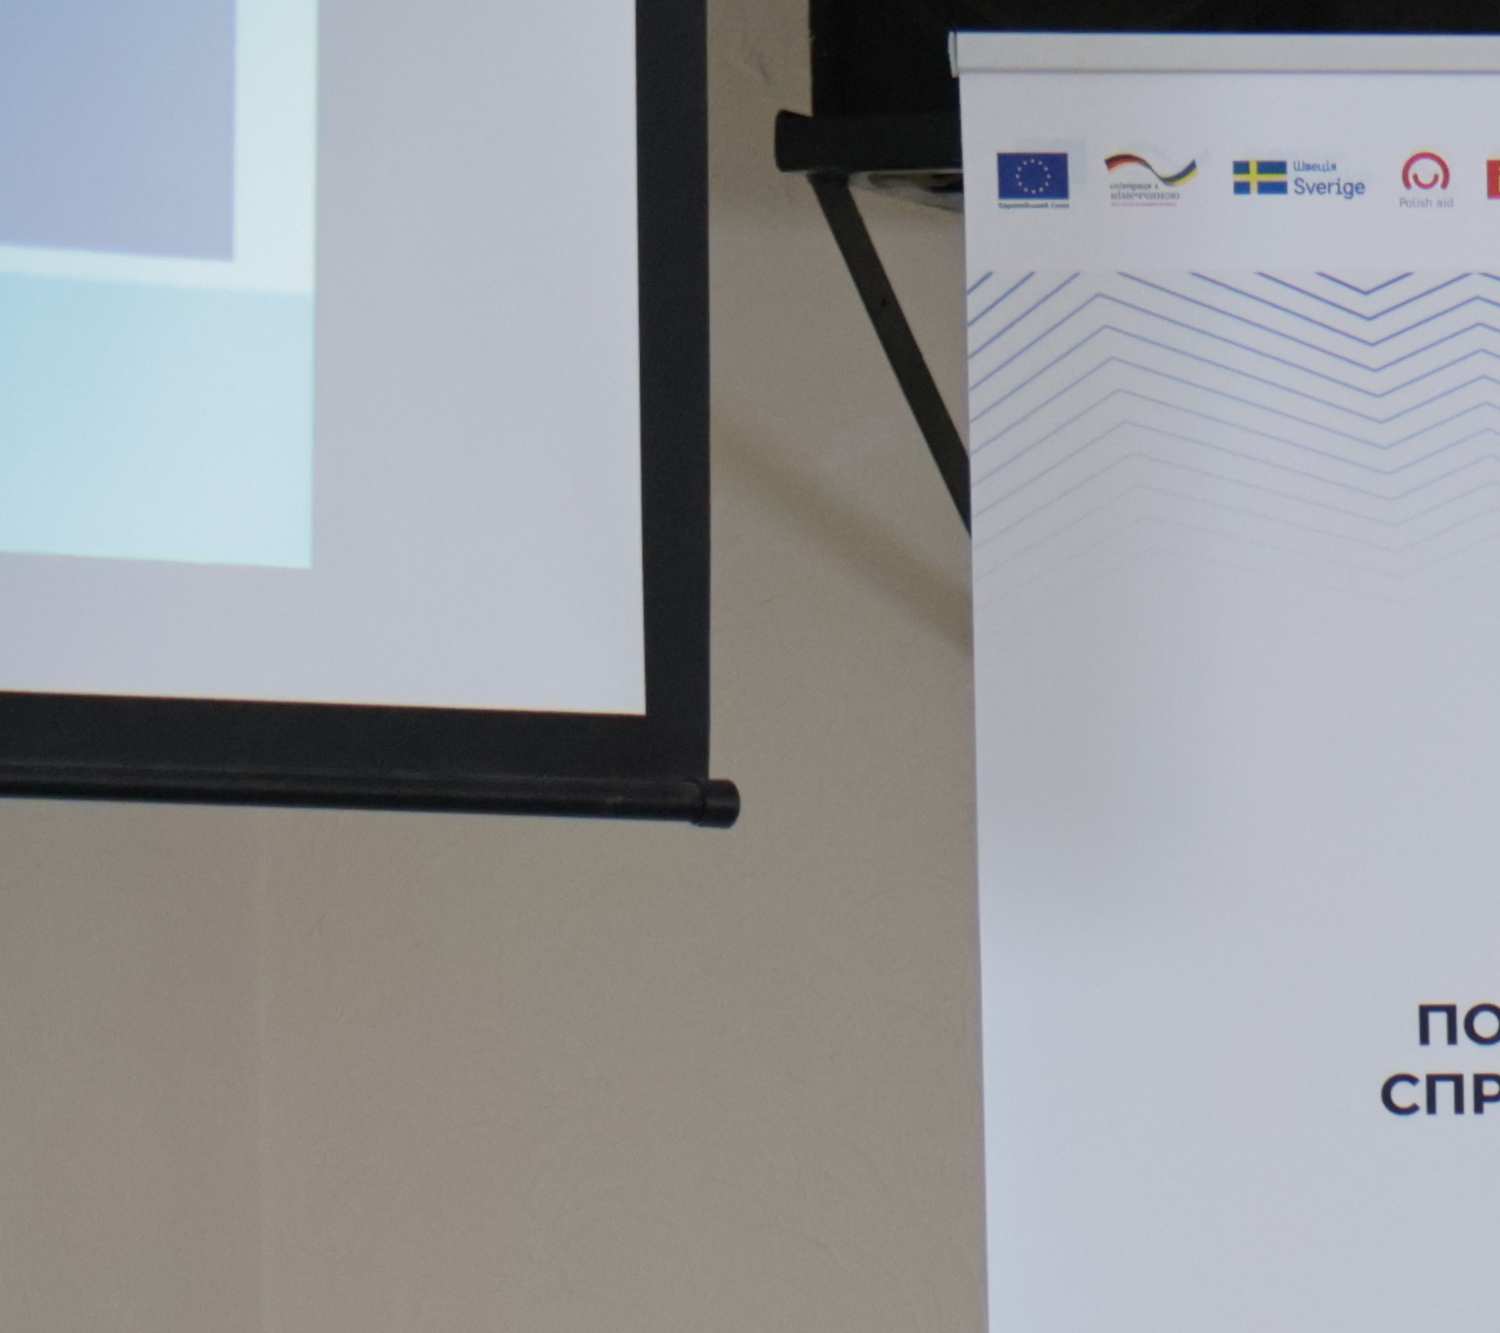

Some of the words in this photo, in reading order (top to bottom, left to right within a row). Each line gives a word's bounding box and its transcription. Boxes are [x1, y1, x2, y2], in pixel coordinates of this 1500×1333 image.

[1293, 160, 1336, 173] Швеція
[1294, 178, 1366, 200] Sverige
[1399, 197, 1432, 208] Polish
[1437, 197, 1454, 208] aid
